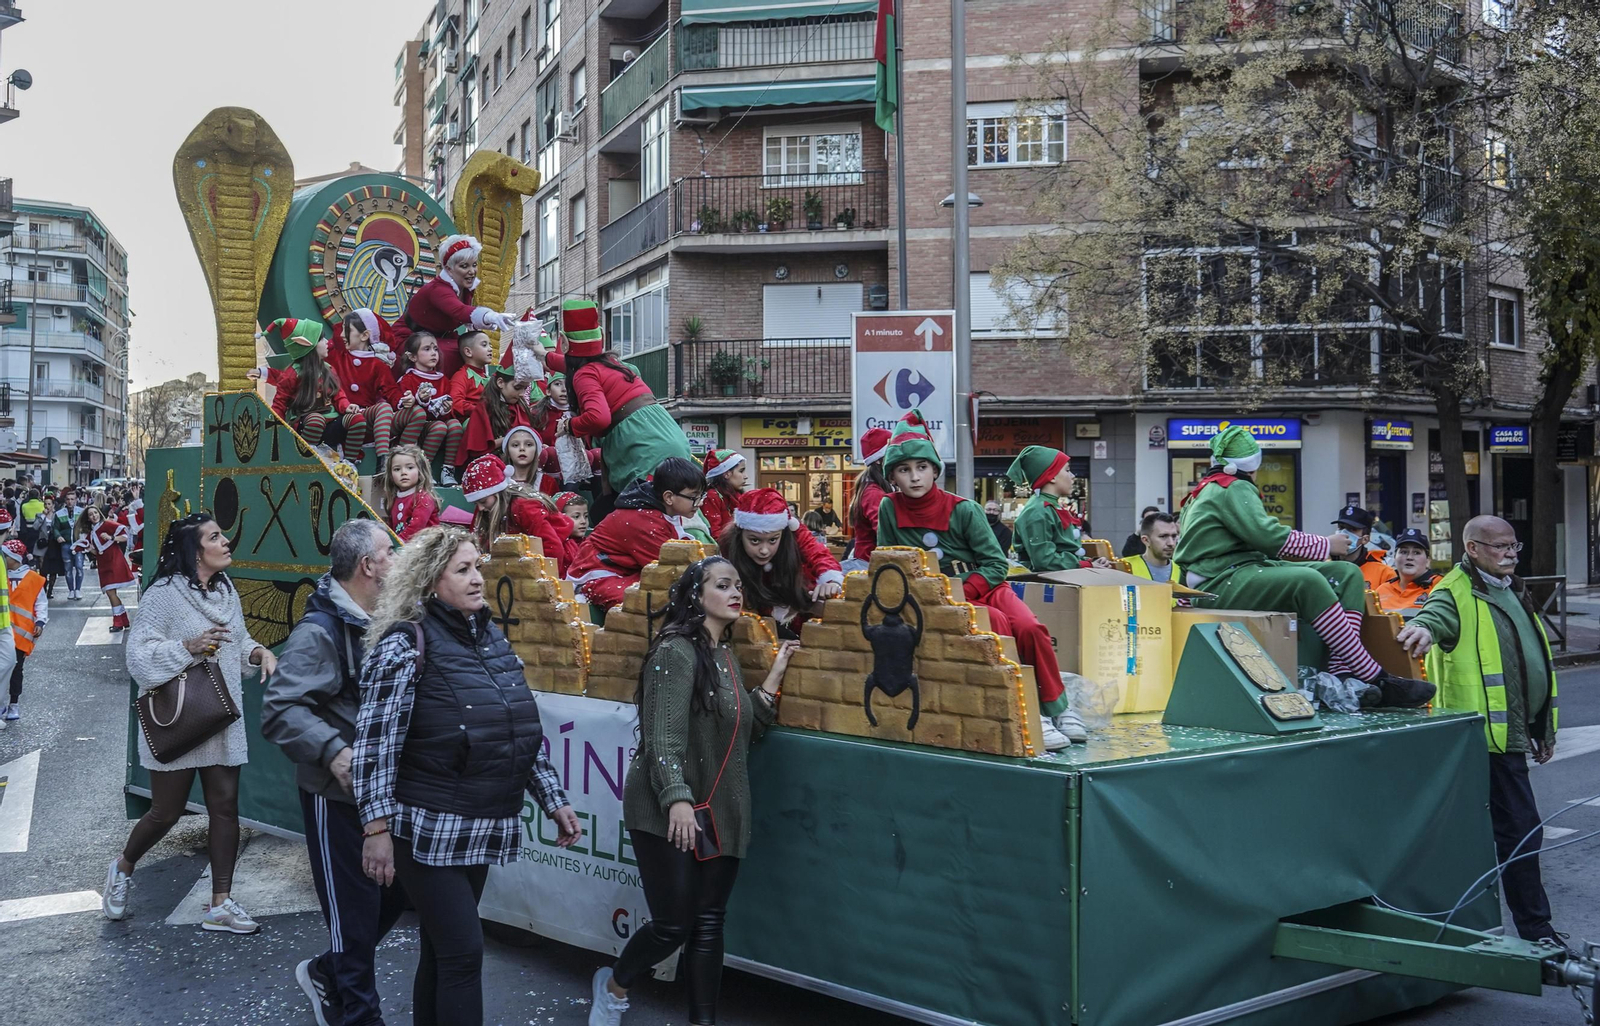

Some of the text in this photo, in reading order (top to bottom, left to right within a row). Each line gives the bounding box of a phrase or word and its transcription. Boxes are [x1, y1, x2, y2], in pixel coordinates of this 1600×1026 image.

[762, 420, 813, 428] Fot
[978, 417, 1040, 426] ELOJERIA
[1181, 426, 1218, 435] SUPER
[1372, 426, 1387, 435] SUPER
[1262, 484, 1287, 493] ORO
[582, 862, 592, 876] Y
